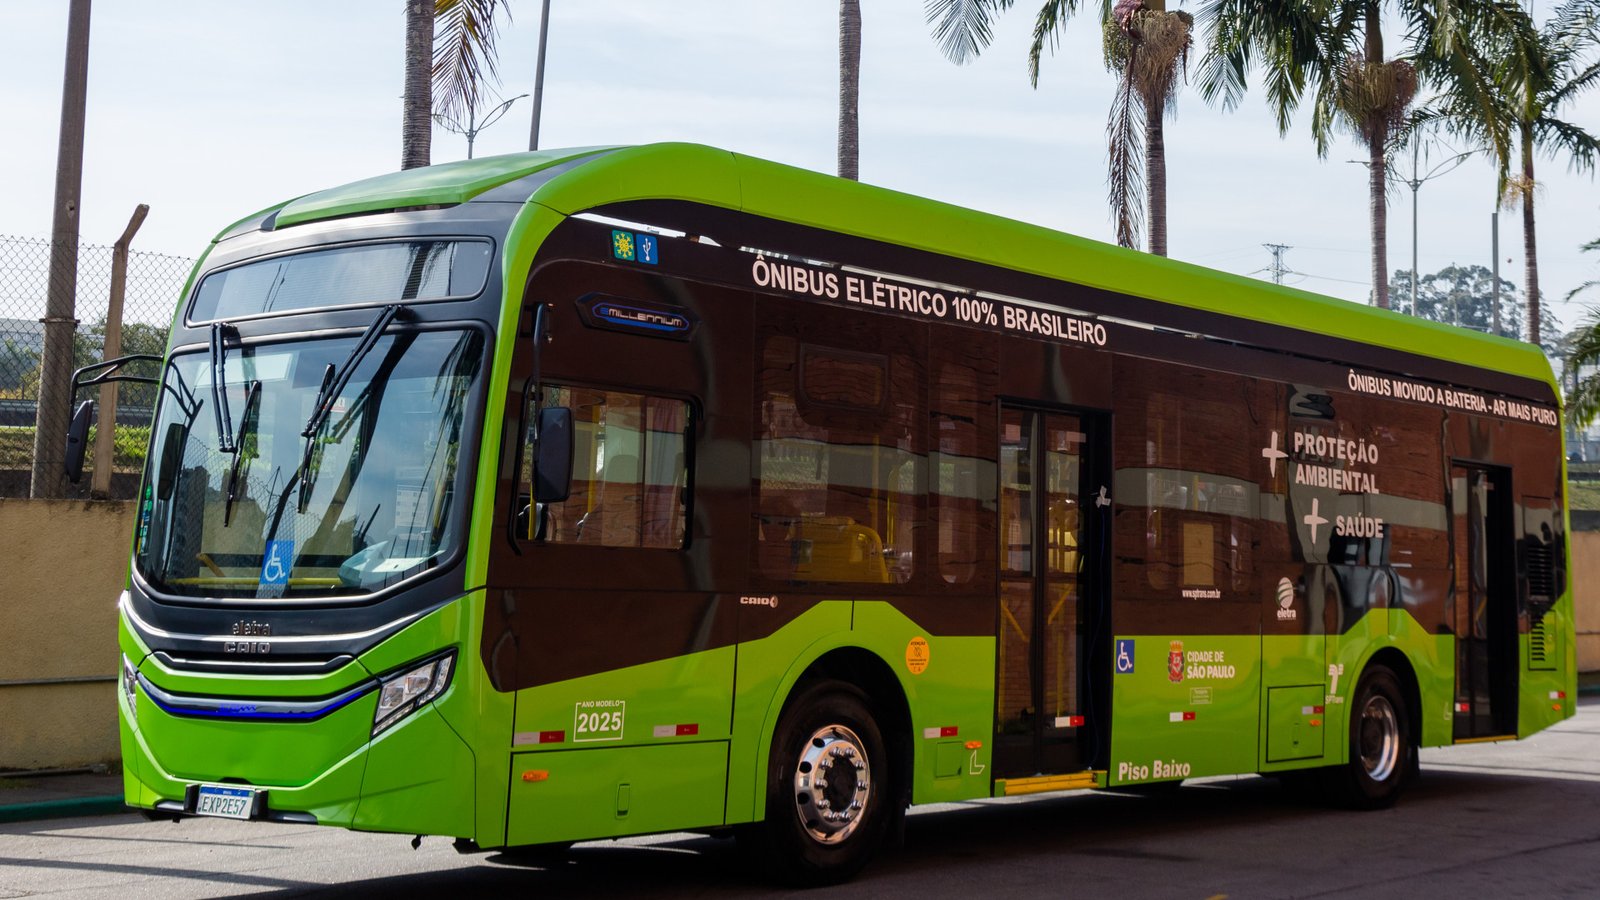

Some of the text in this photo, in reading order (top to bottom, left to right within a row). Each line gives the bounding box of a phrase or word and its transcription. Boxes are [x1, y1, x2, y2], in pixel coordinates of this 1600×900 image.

[752, 254, 1107, 346] ÔNIBUS ELÉTRICO 100% BRASILEIRO
[1348, 368, 1391, 397] ÔNIBUS
[1393, 380, 1434, 403] MOVIDO
[1436, 390, 1444, 405] A
[1445, 391, 1487, 413] BATERIA
[1493, 399, 1507, 416] AR
[1508, 402, 1531, 420] MAIS
[1532, 406, 1557, 426] PURO
[1294, 431, 1379, 466] PROTEÇÃO
[1295, 463, 1379, 494] AMBIENTAL
[1336, 512, 1384, 538] SAÚDE
[740, 596, 770, 605] CAIO
[1277, 607, 1297, 618] eletra
[1187, 651, 1224, 662] CIDADE DE
[1187, 663, 1235, 679] SÃO PAULO
[577, 712, 621, 732] 2025
[1118, 759, 1191, 781] Piso Baixo
[201, 796, 247, 816] EXP2E57
